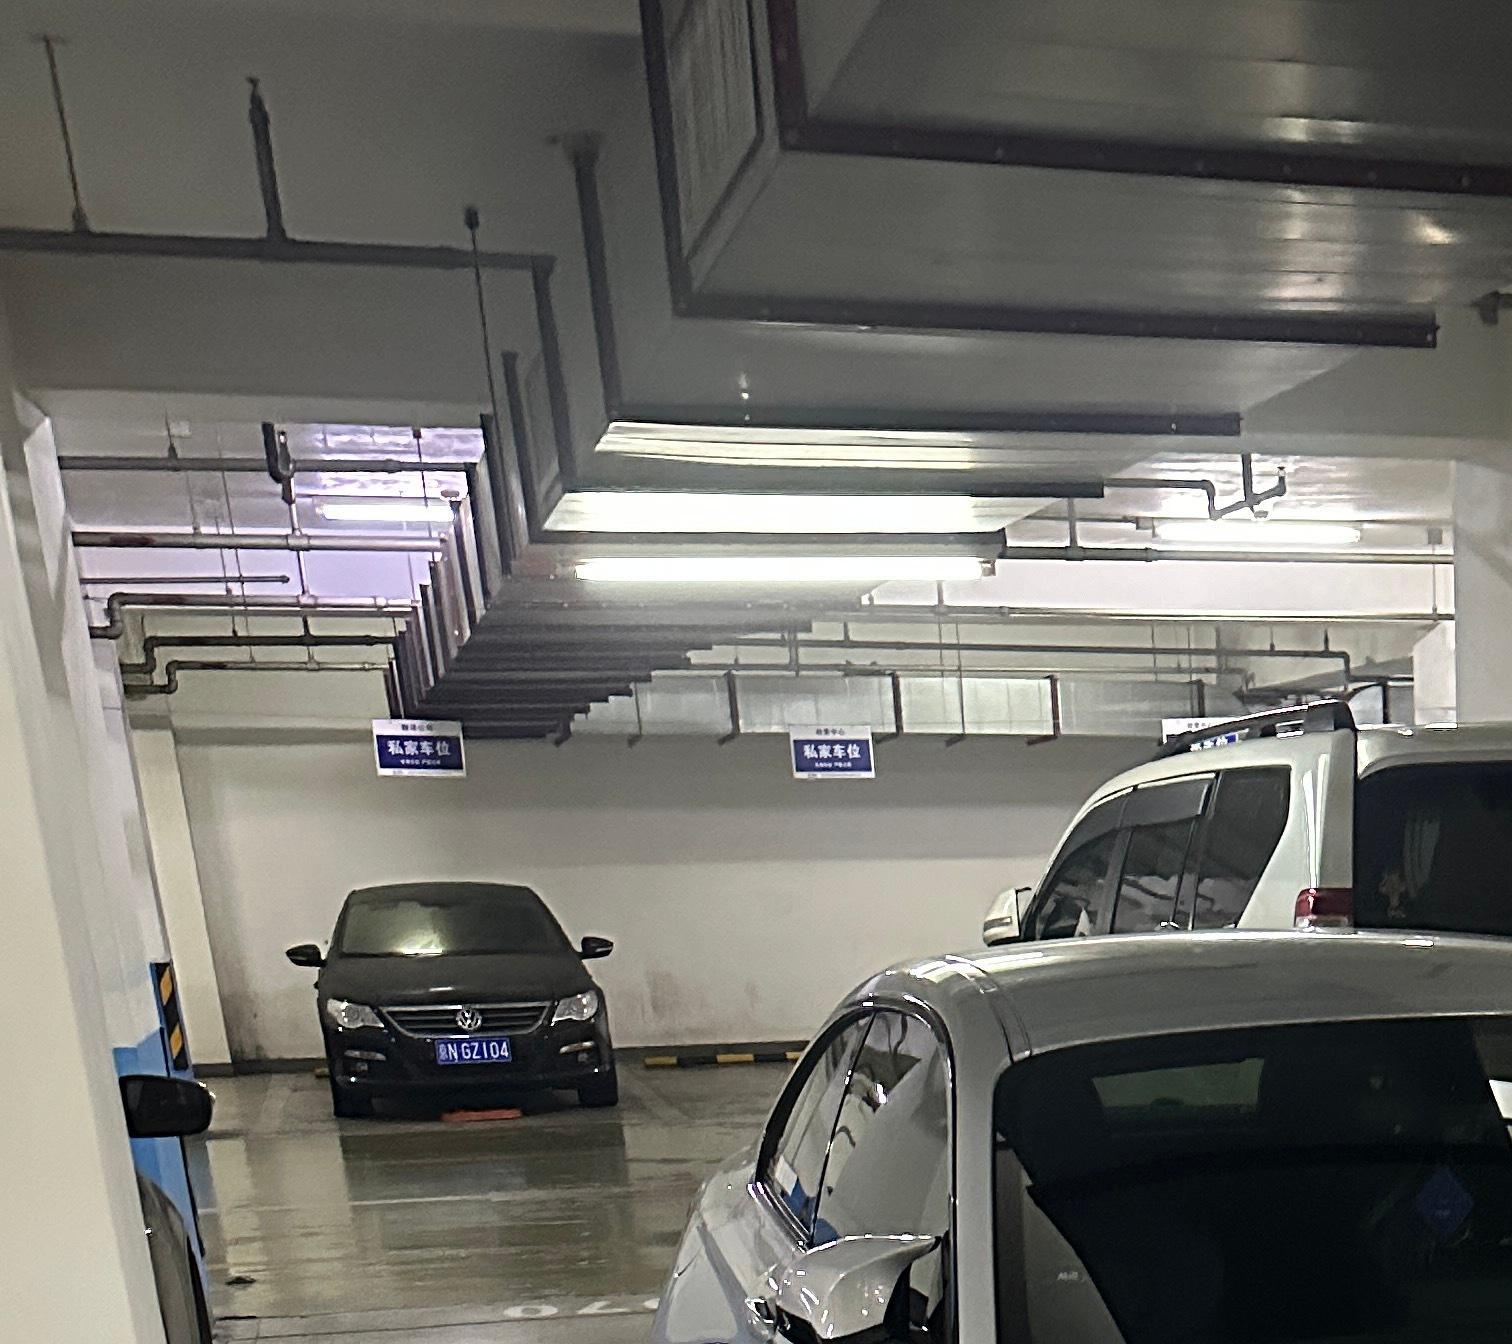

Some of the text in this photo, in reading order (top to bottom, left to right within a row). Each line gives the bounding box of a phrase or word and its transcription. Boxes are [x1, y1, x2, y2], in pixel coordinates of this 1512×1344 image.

[386, 740, 451, 757] 私家车位
[802, 743, 862, 760] 私家车位
